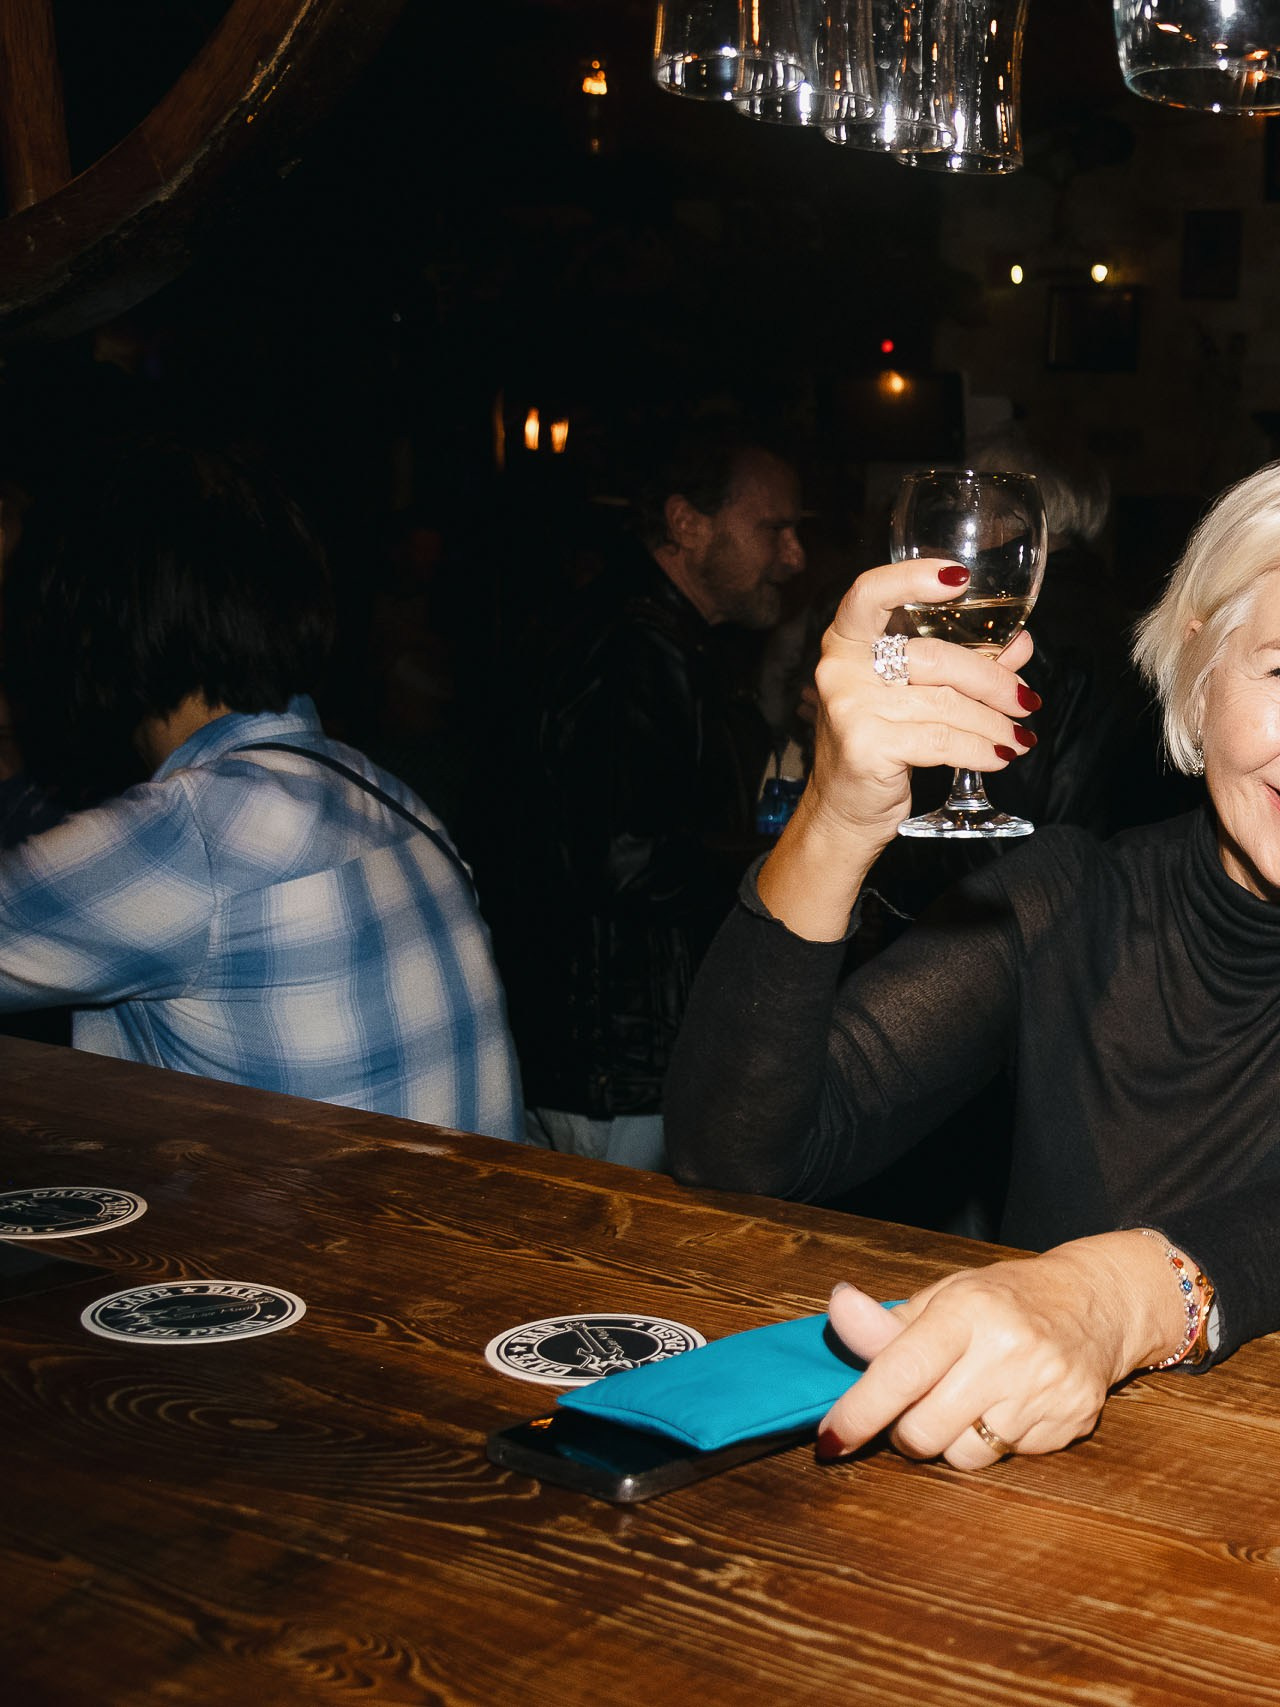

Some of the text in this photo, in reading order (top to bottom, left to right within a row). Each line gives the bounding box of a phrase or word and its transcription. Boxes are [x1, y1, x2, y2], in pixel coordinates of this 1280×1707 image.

[107, 1285, 264, 1310] CAFE BAR
[138, 1320, 269, 1336] EL PASO
[647, 1324, 686, 1351] PASO
[507, 1325, 572, 1376] CAFE BAR
